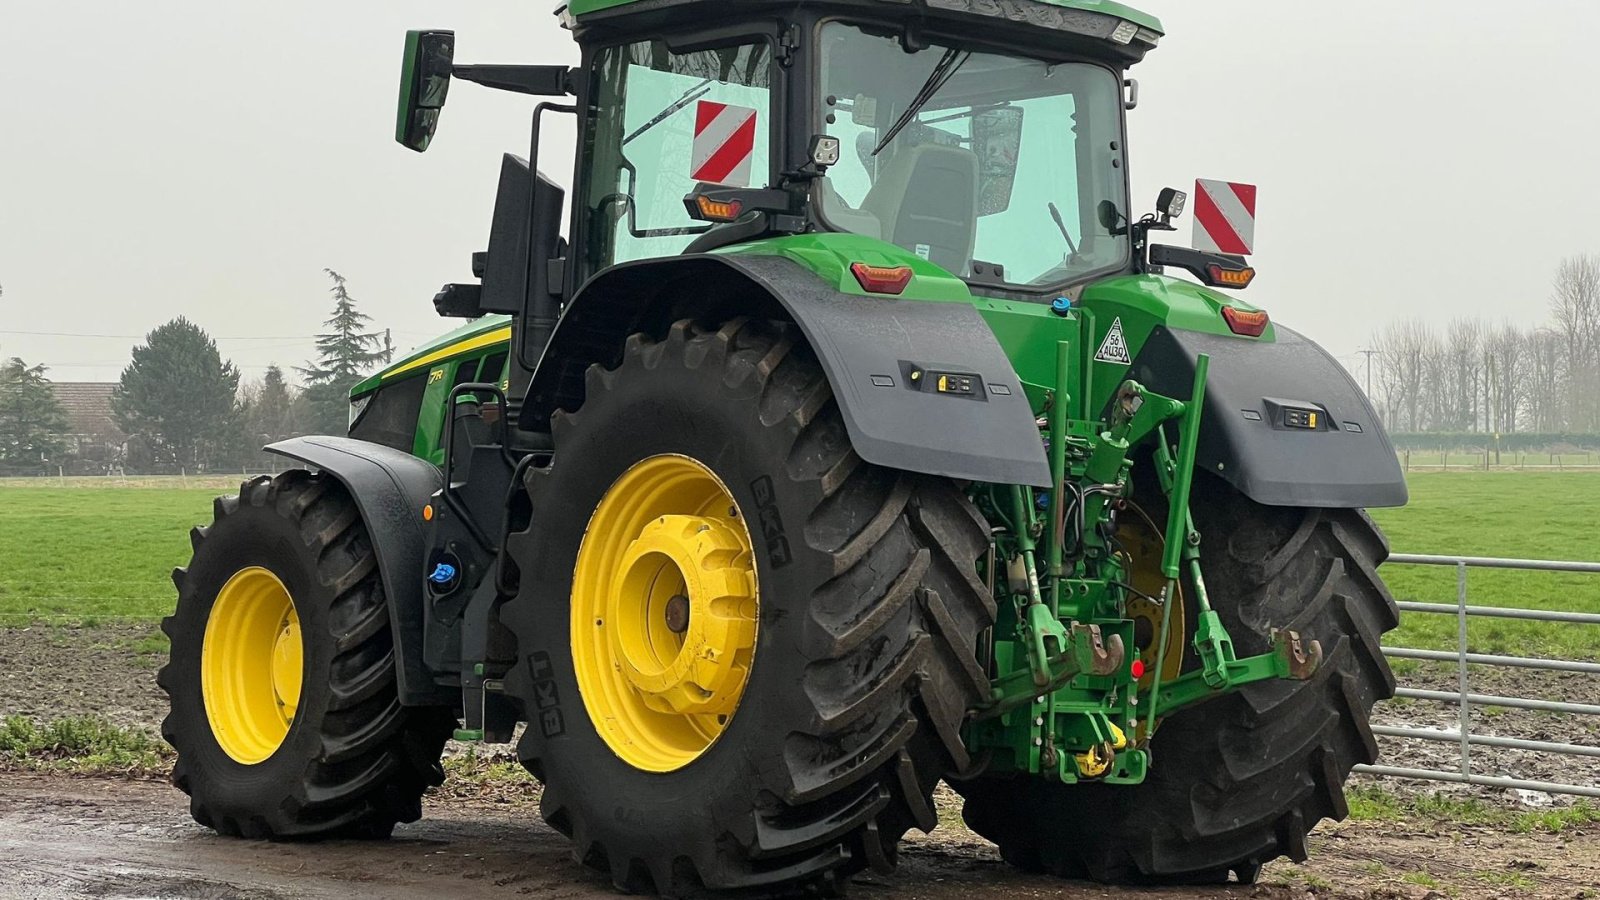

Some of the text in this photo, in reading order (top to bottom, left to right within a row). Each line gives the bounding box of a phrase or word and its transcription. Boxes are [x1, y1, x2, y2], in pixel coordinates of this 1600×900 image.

[1110, 335, 1119, 345] 56
[429, 369, 444, 385] 7R
[751, 475, 792, 568] BKT
[528, 651, 565, 737] BKT
